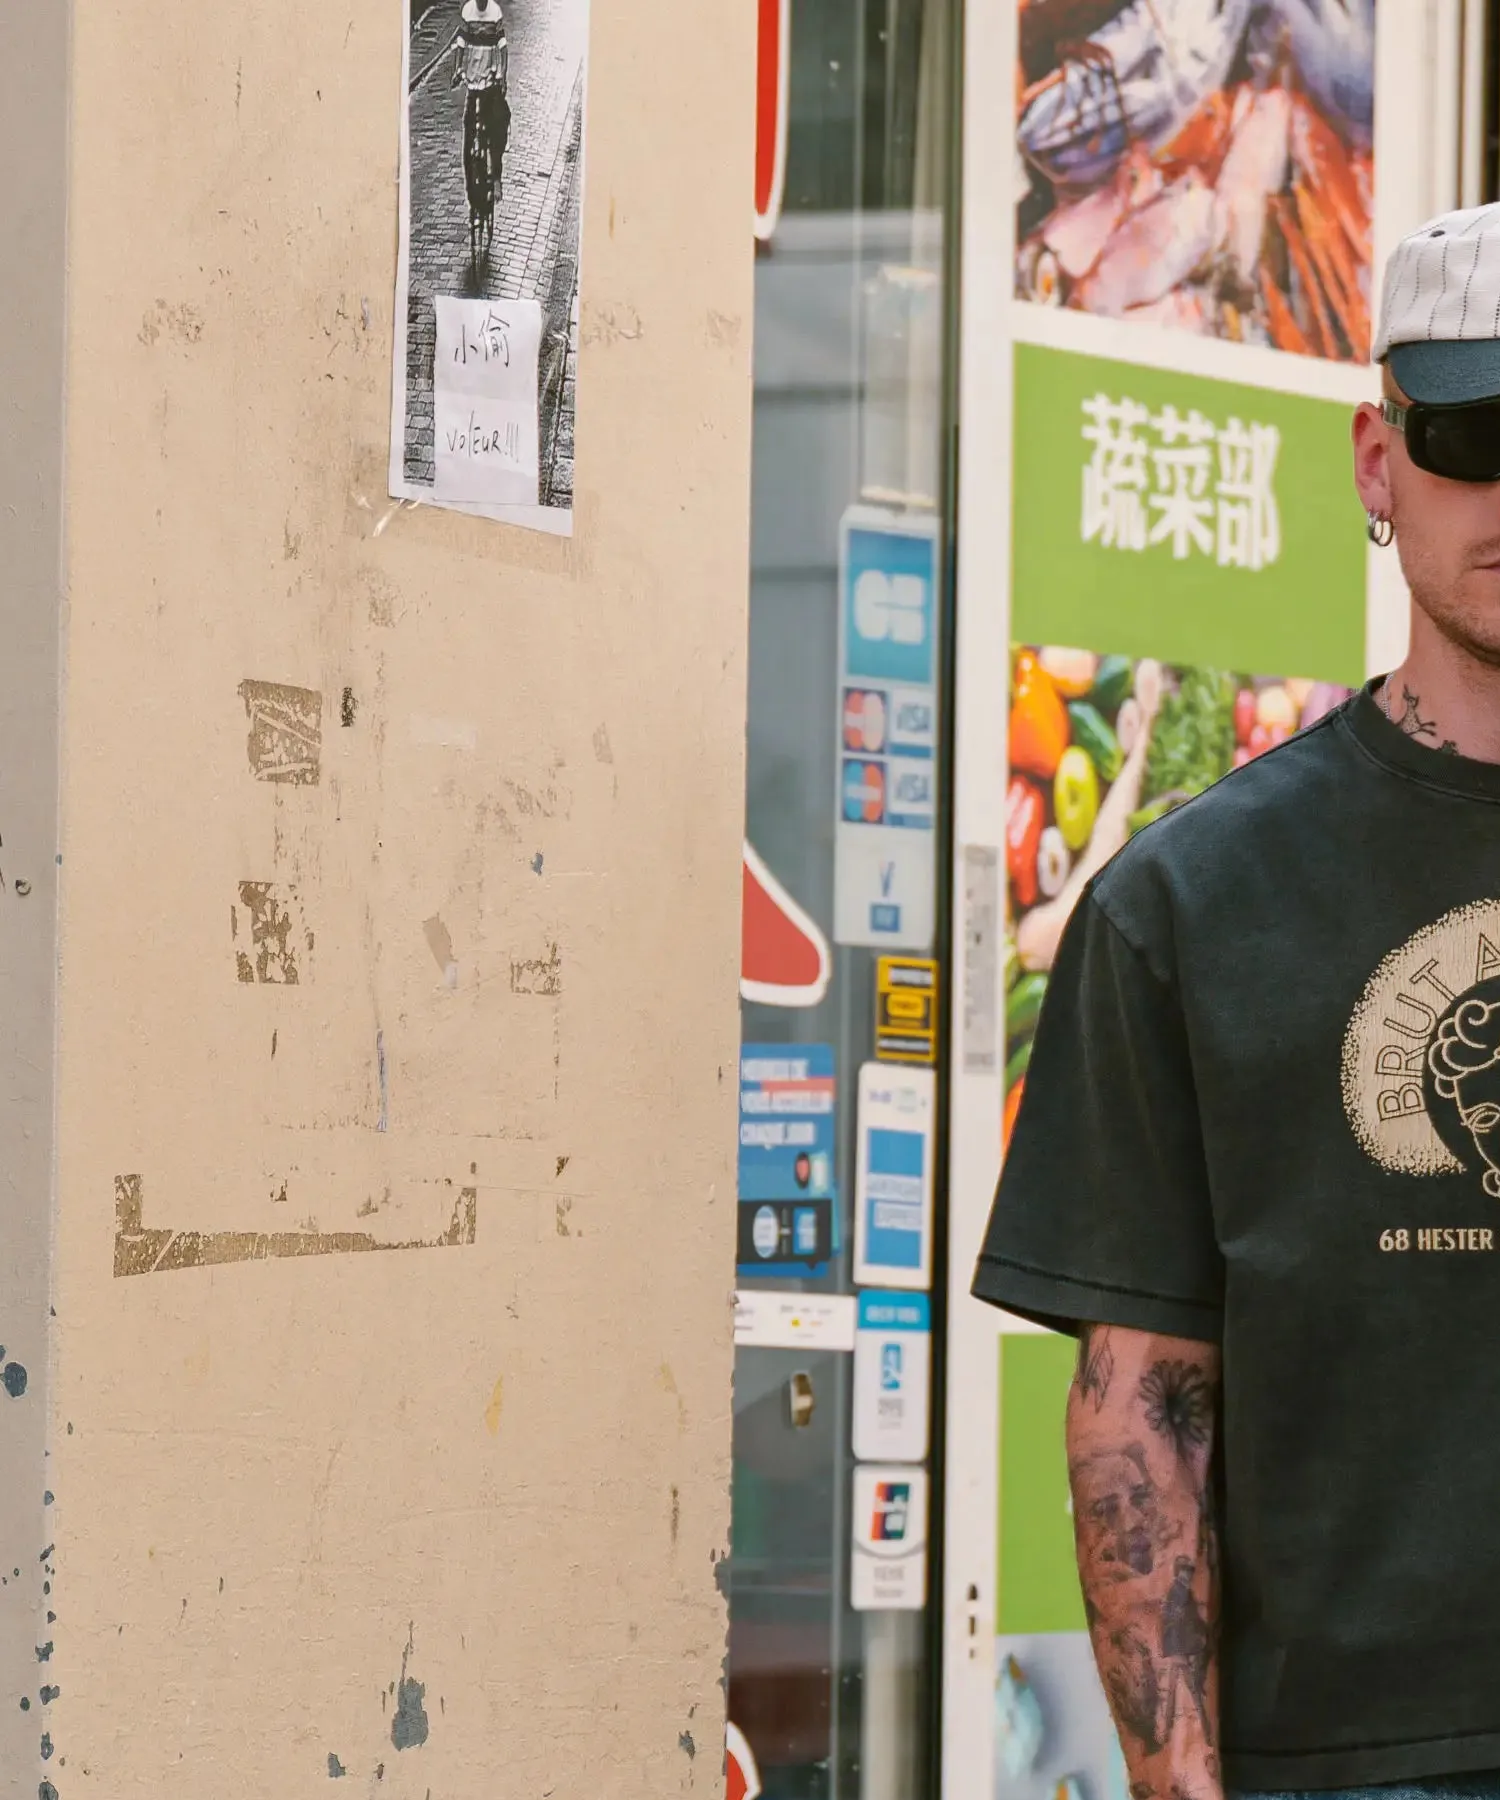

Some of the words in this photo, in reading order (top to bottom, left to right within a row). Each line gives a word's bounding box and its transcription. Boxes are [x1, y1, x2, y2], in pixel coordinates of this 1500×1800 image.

[453, 308, 511, 368] 小偷
[1081, 393, 1281, 573] 蔬菜部
[1375, 958, 1457, 1122] BRUT
[1379, 1229, 1409, 1252] 68
[1417, 1228, 1493, 1251] HESTER
